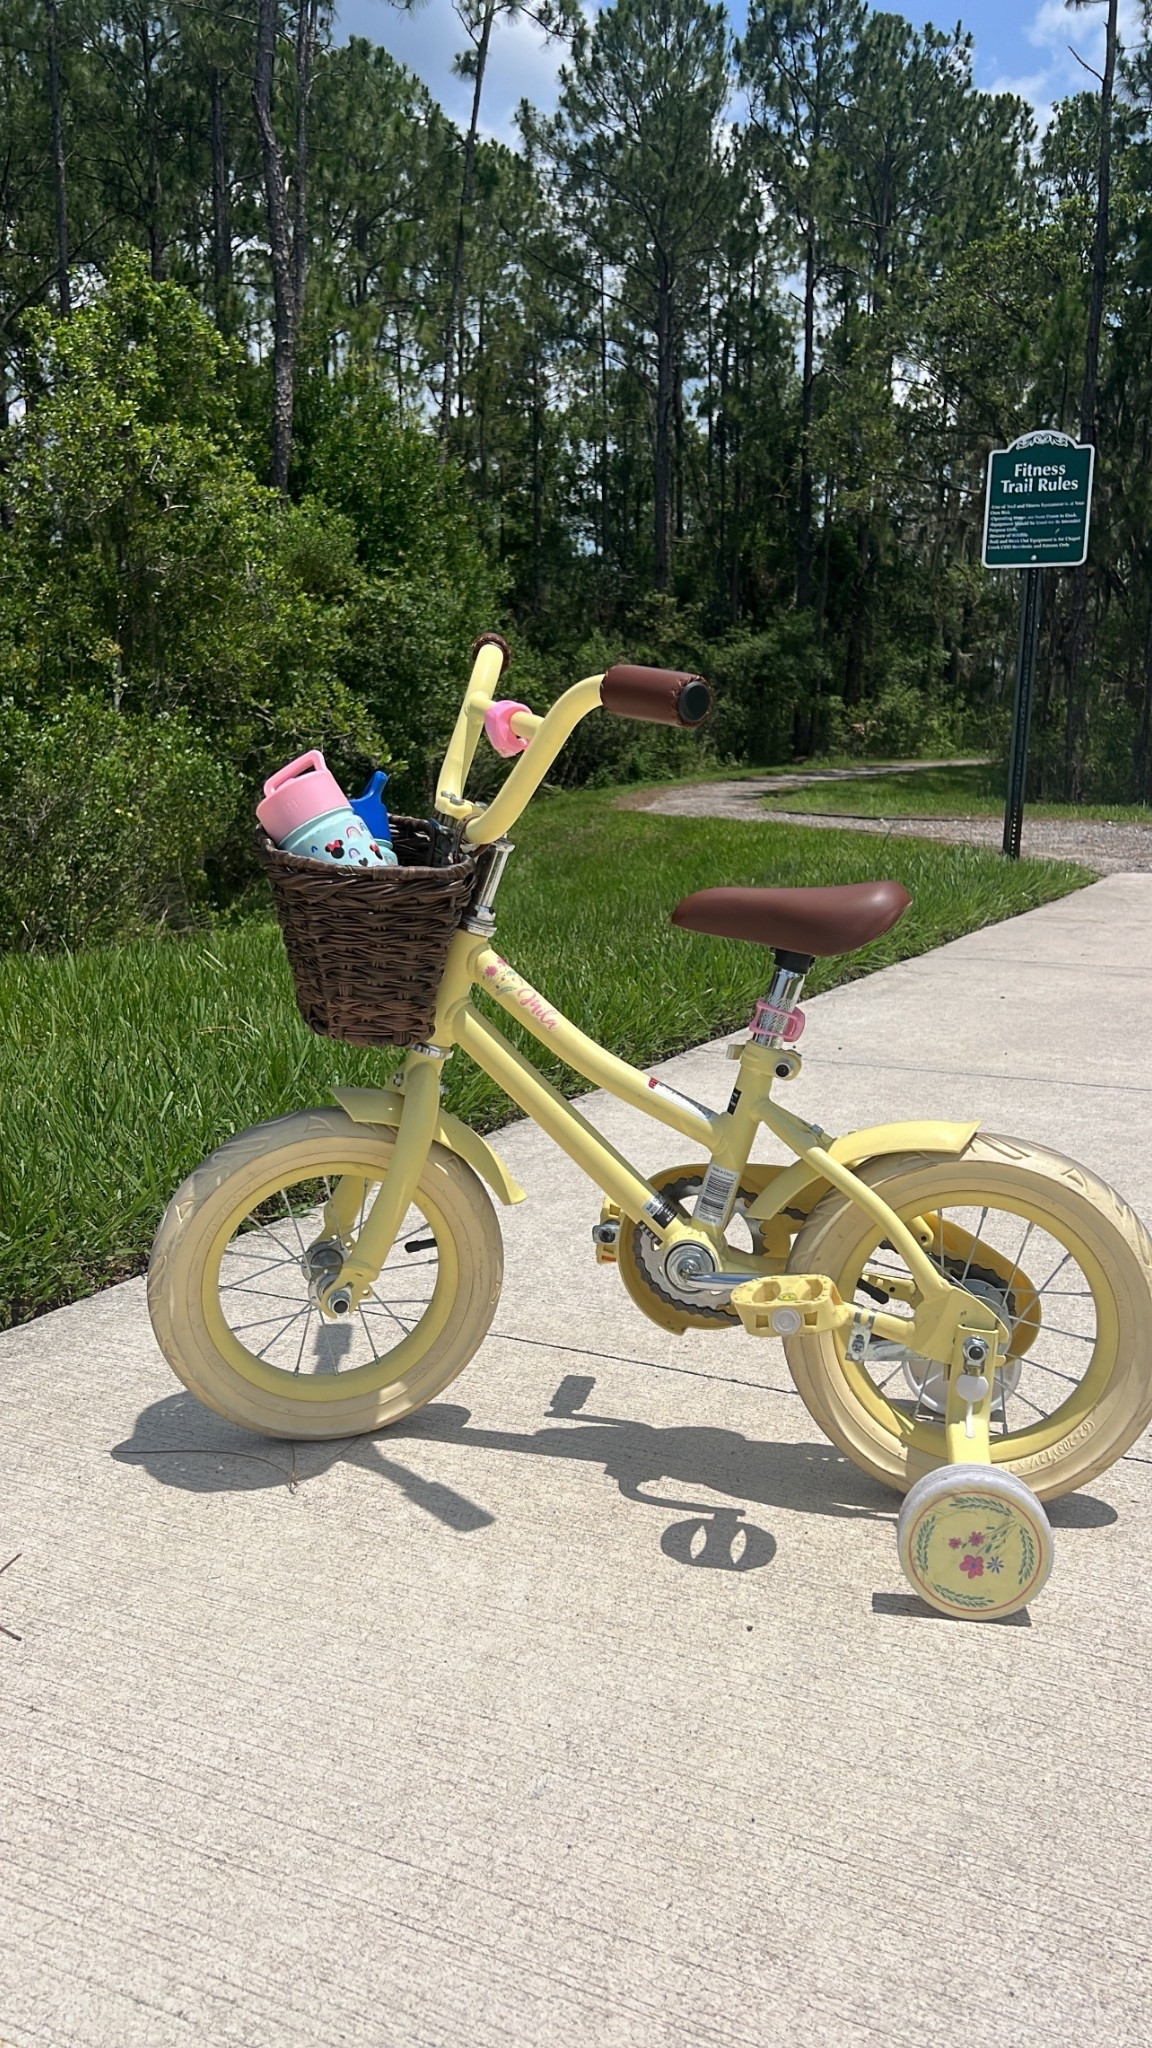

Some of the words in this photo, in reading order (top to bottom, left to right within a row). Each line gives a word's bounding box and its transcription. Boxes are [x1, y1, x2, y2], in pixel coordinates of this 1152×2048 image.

[1014, 463, 1066, 477] Fitness
[1000, 478, 1033, 494] Trail
[1038, 476, 1078, 492] Rules
